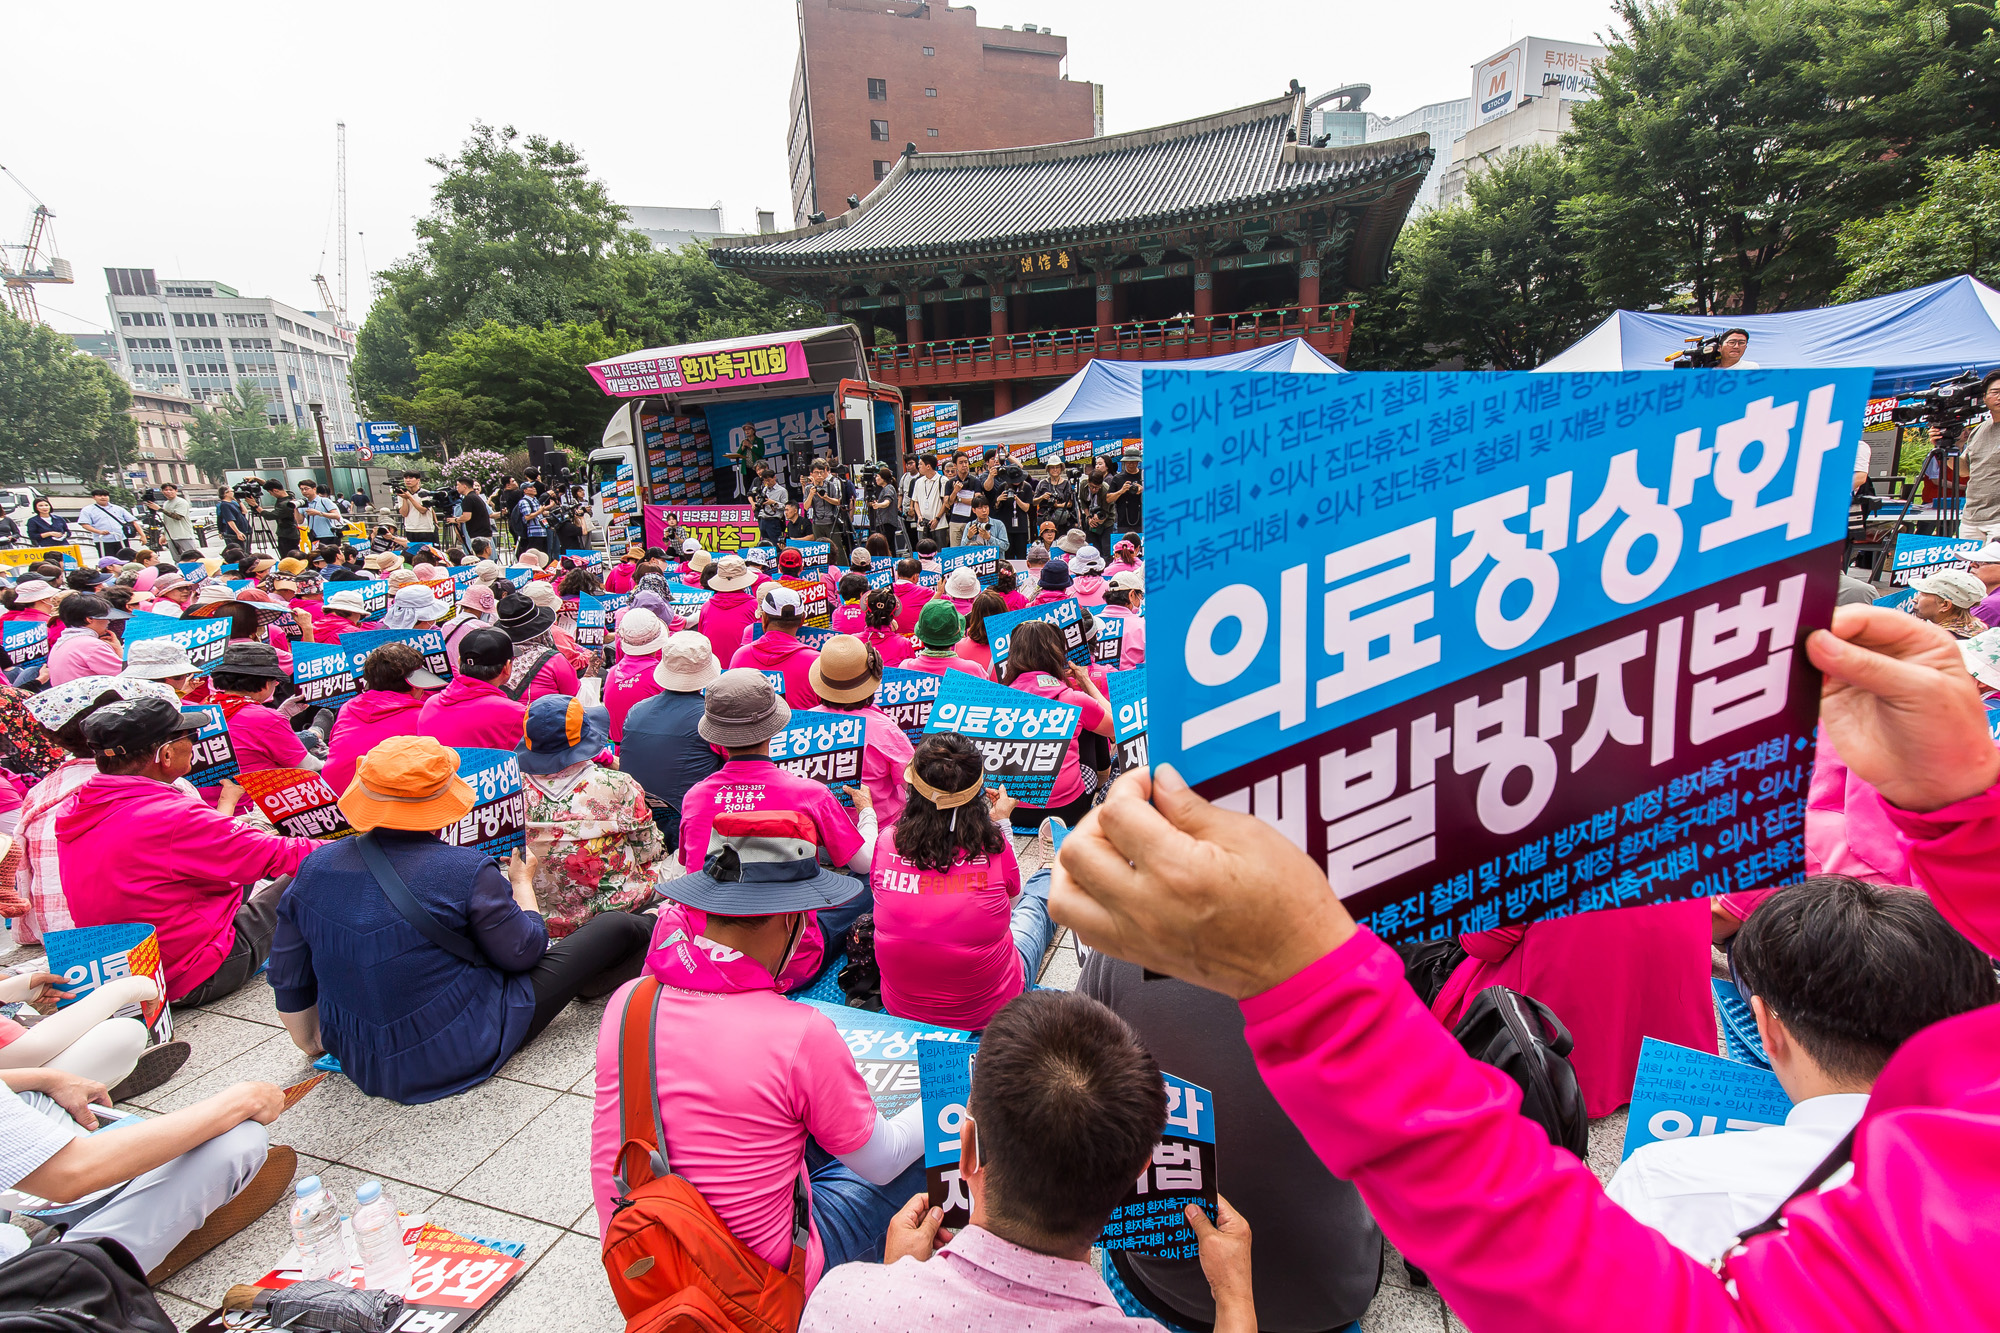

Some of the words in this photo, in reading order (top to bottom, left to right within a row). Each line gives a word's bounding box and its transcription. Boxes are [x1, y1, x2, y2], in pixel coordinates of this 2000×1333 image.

[1544, 50, 1589, 72] 투자하는
[1487, 97, 1504, 110] STOCK
[601, 364, 620, 378] 의사
[620, 361, 656, 376] 집단휴진
[657, 357, 677, 373] 철회
[680, 345, 787, 383] 환자촉구대회
[606, 373, 659, 393] 재발방지법
[659, 372, 682, 389] 제정
[1171, 388, 1222, 433] 의사
[1864, 399, 1897, 416] 정상화
[1144, 449, 1192, 493] 대회
[1220, 422, 1271, 467] 의사
[1277, 388, 1374, 451] 집단휴진
[1380, 373, 1428, 416] 철회
[1145, 479, 1241, 541] 촉구대회
[1268, 454, 1319, 496] 의사
[1325, 419, 1420, 481] 집단휴진
[1427, 401, 1475, 447] 철회
[1484, 391, 1507, 429] 및
[1513, 373, 1562, 415] 재발
[1145, 509, 1288, 596] 환자촉구대회
[1315, 483, 1366, 527] 의사
[1372, 447, 1467, 511] 집단휴진
[1473, 430, 1521, 477] 철회
[1529, 419, 1553, 456] 및
[1559, 401, 1610, 444] 재발
[1615, 375, 1686, 430] 방지법
[682, 510, 718, 522] 집단휴진
[720, 510, 739, 522] 철회
[681, 525, 761, 553] 자촉구
[944, 547, 997, 571] 의료정상화
[1181, 383, 1844, 750] 의료정상화
[799, 583, 827, 601] 정상화
[5, 622, 47, 649] 의료정상화
[298, 652, 349, 679] 의료정상
[933, 703, 1075, 737] 의료정상화
[774, 750, 858, 780] 방지법
[975, 739, 1062, 771] 방지법
[714, 792, 766, 805] 울릉심층수
[724, 803, 755, 814] 청아라
[1429, 868, 1473, 917] 철회
[1479, 856, 1501, 894] 및
[1505, 835, 1550, 878] 재발
[1553, 806, 1617, 859] 방지법
[1620, 785, 1663, 826] 제정
[1666, 734, 1790, 809] 환자촉구대회
[1458, 895, 1502, 936] 재발
[1506, 863, 1568, 919] 방지법
[1571, 843, 1614, 884] 제정
[1617, 788, 1738, 865] 환자촉구대회
[1757, 764, 1803, 801] 의사
[1576, 841, 1698, 914] 환자촉구대회
[1717, 817, 1760, 854] 의사
[926, 1046, 945, 1057] 의사
[947, 1044, 977, 1055] 집단휴
[1653, 1050, 1681, 1062] 의사
[946, 1059, 964, 1070] 의사
[1676, 1066, 1704, 1078] 의사
[1709, 1069, 1766, 1086] 집단휴진
[1701, 1082, 1729, 1095] 의사
[1724, 1099, 1754, 1112] 의사
[1757, 1103, 1789, 1117] 집단
[1124, 1203, 1145, 1216] 제정
[1103, 1223, 1123, 1237] 제정
[1125, 1212, 1184, 1234] 환자촉구대회
[1106, 1233, 1165, 1251] 환자촉구대회
